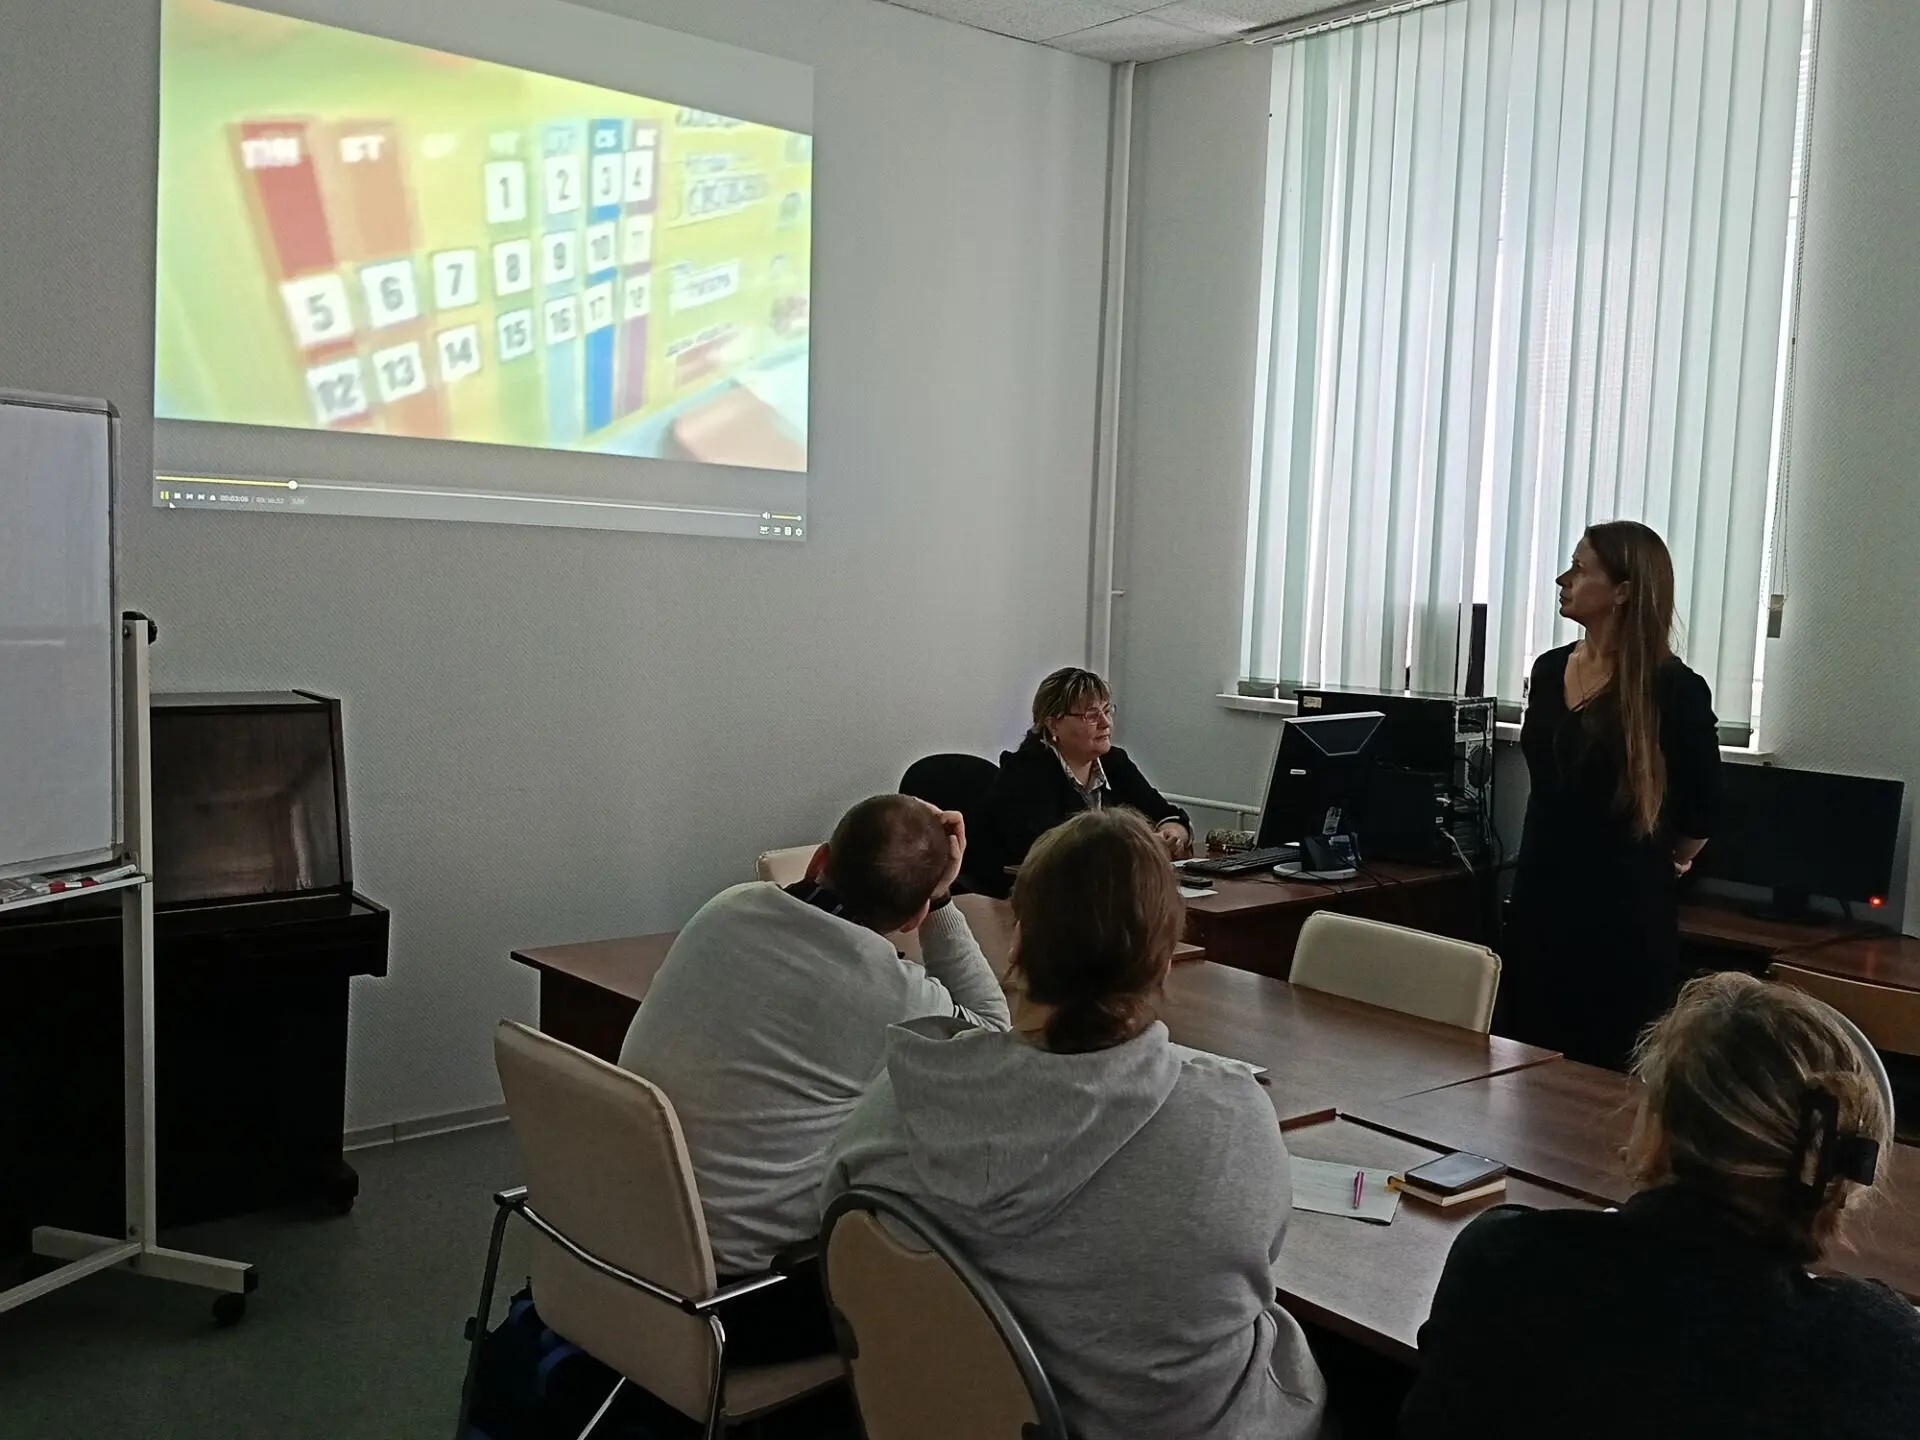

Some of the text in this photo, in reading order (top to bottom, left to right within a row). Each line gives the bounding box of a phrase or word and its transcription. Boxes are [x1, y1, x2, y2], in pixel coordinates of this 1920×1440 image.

[498, 176, 511, 209] 1
[555, 168, 571, 201] 2
[602, 166, 613, 197] 3
[308, 292, 334, 333] 5
[379, 275, 405, 312] 6
[446, 262, 464, 297] 7
[505, 252, 521, 284] 8
[553, 241, 568, 271] 9
[317, 373, 358, 413] 12
[382, 354, 416, 391] 13
[445, 336, 473, 369] 14
[503, 322, 527, 350] 15
[550, 308, 571, 335] 16
